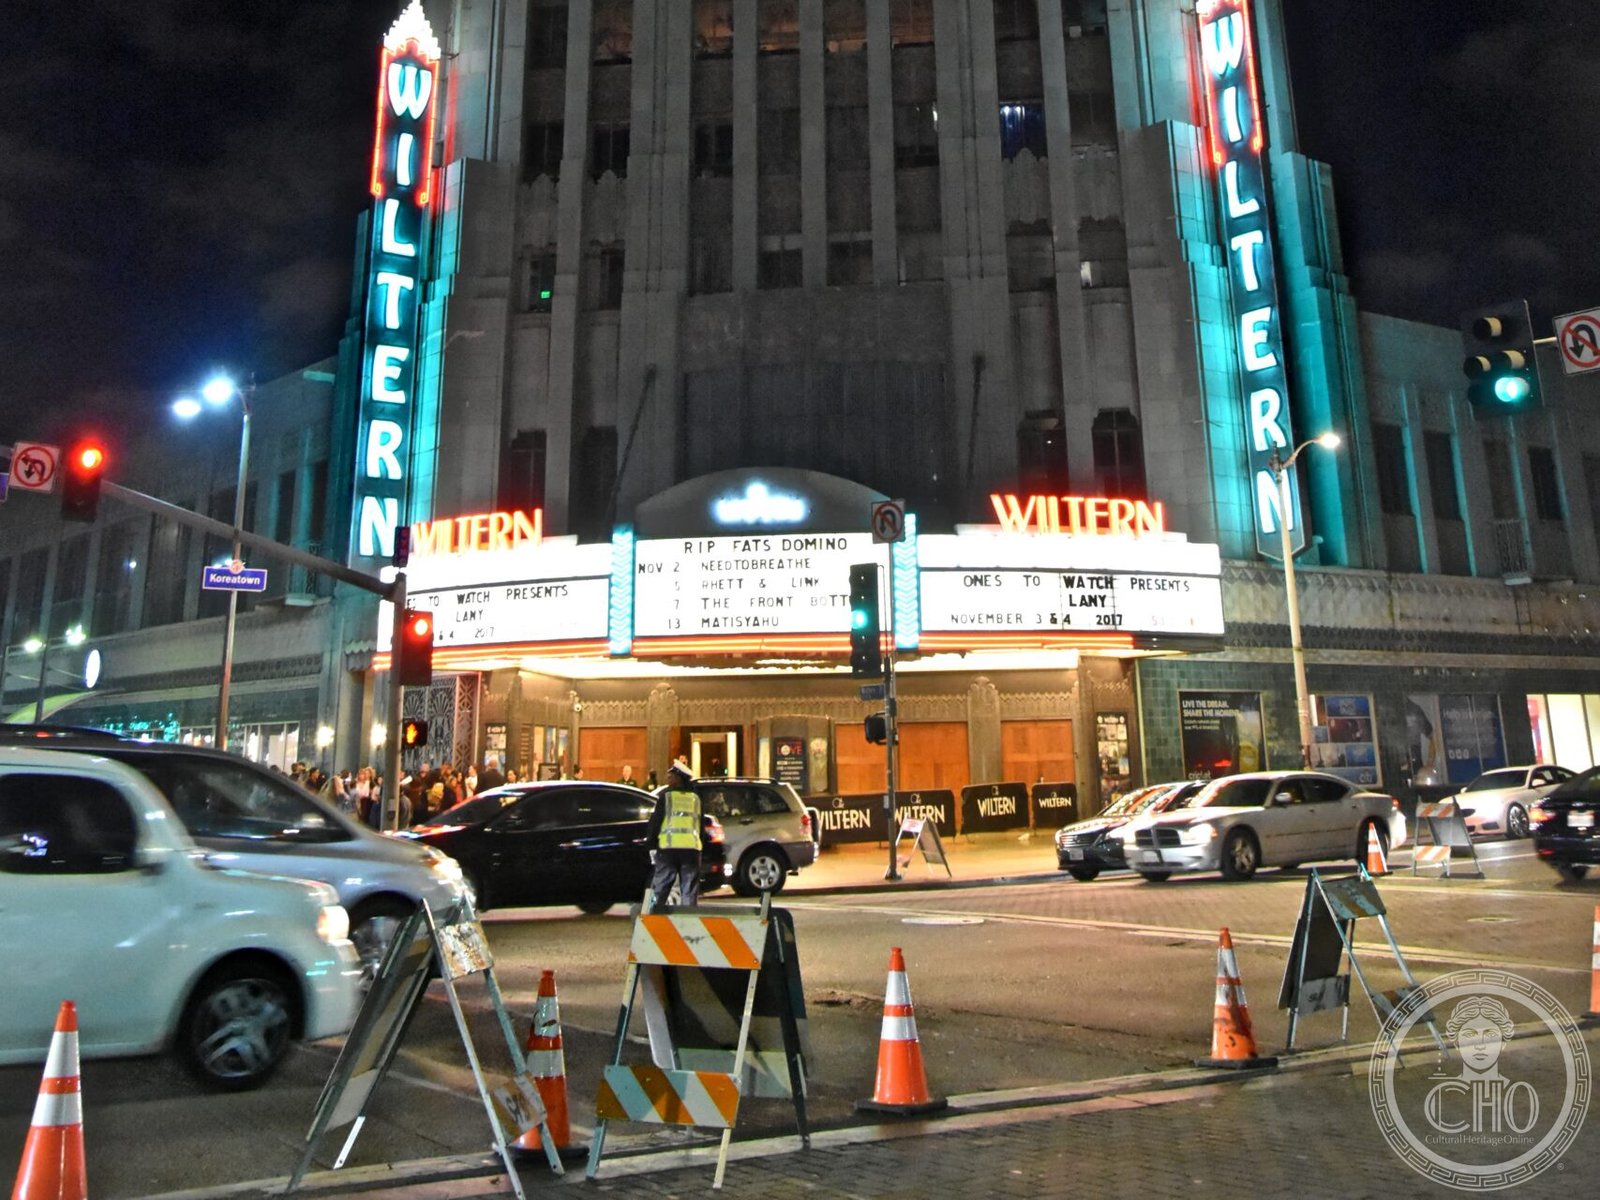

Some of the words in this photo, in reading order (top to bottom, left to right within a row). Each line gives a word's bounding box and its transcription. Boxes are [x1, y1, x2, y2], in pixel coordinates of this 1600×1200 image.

[1202, 12, 1293, 535] WILTERN
[360, 63, 431, 557] WILTERN
[989, 494, 1164, 538] WILTERN
[411, 509, 542, 557] WILTERN
[684, 540, 715, 554] RIP
[733, 539, 771, 553] FATS
[782, 538, 847, 552] DOMINO
[638, 562, 663, 574] NOV
[673, 562, 680, 572] 2
[701, 558, 811, 571] NEEDTOBREATHE
[209, 573, 261, 585] Koreatown
[702, 578, 743, 590] RHETT
[759, 579, 766, 588] &
[791, 577, 819, 588] LINK
[963, 575, 1002, 587] ONES
[1023, 575, 1041, 587] TO
[1063, 575, 1114, 590] WATCH
[1130, 577, 1190, 592] PRESENTS
[429, 595, 440, 607] TO
[456, 591, 490, 605] WATCH
[506, 584, 568, 600] PRESENTS
[673, 599, 680, 610] 7
[701, 597, 730, 610] THE
[750, 596, 793, 607] FRONT
[810, 594, 848, 607] BOTT
[1069, 594, 1107, 608] LANY
[456, 609, 483, 623] LANY
[668, 618, 680, 629] 13
[701, 616, 779, 628] MATISYAHU
[951, 613, 1023, 624] NOVEMBER
[1036, 613, 1042, 624] 3
[1050, 613, 1058, 624] &
[1063, 614, 1071, 625] 4
[1095, 614, 1123, 626] 2017
[1196, 700, 1206, 708] THE
[1203, 709, 1213, 717] THE
[977, 797, 1016, 818] WILTERN
[1038, 797, 1072, 808] WILTERN
